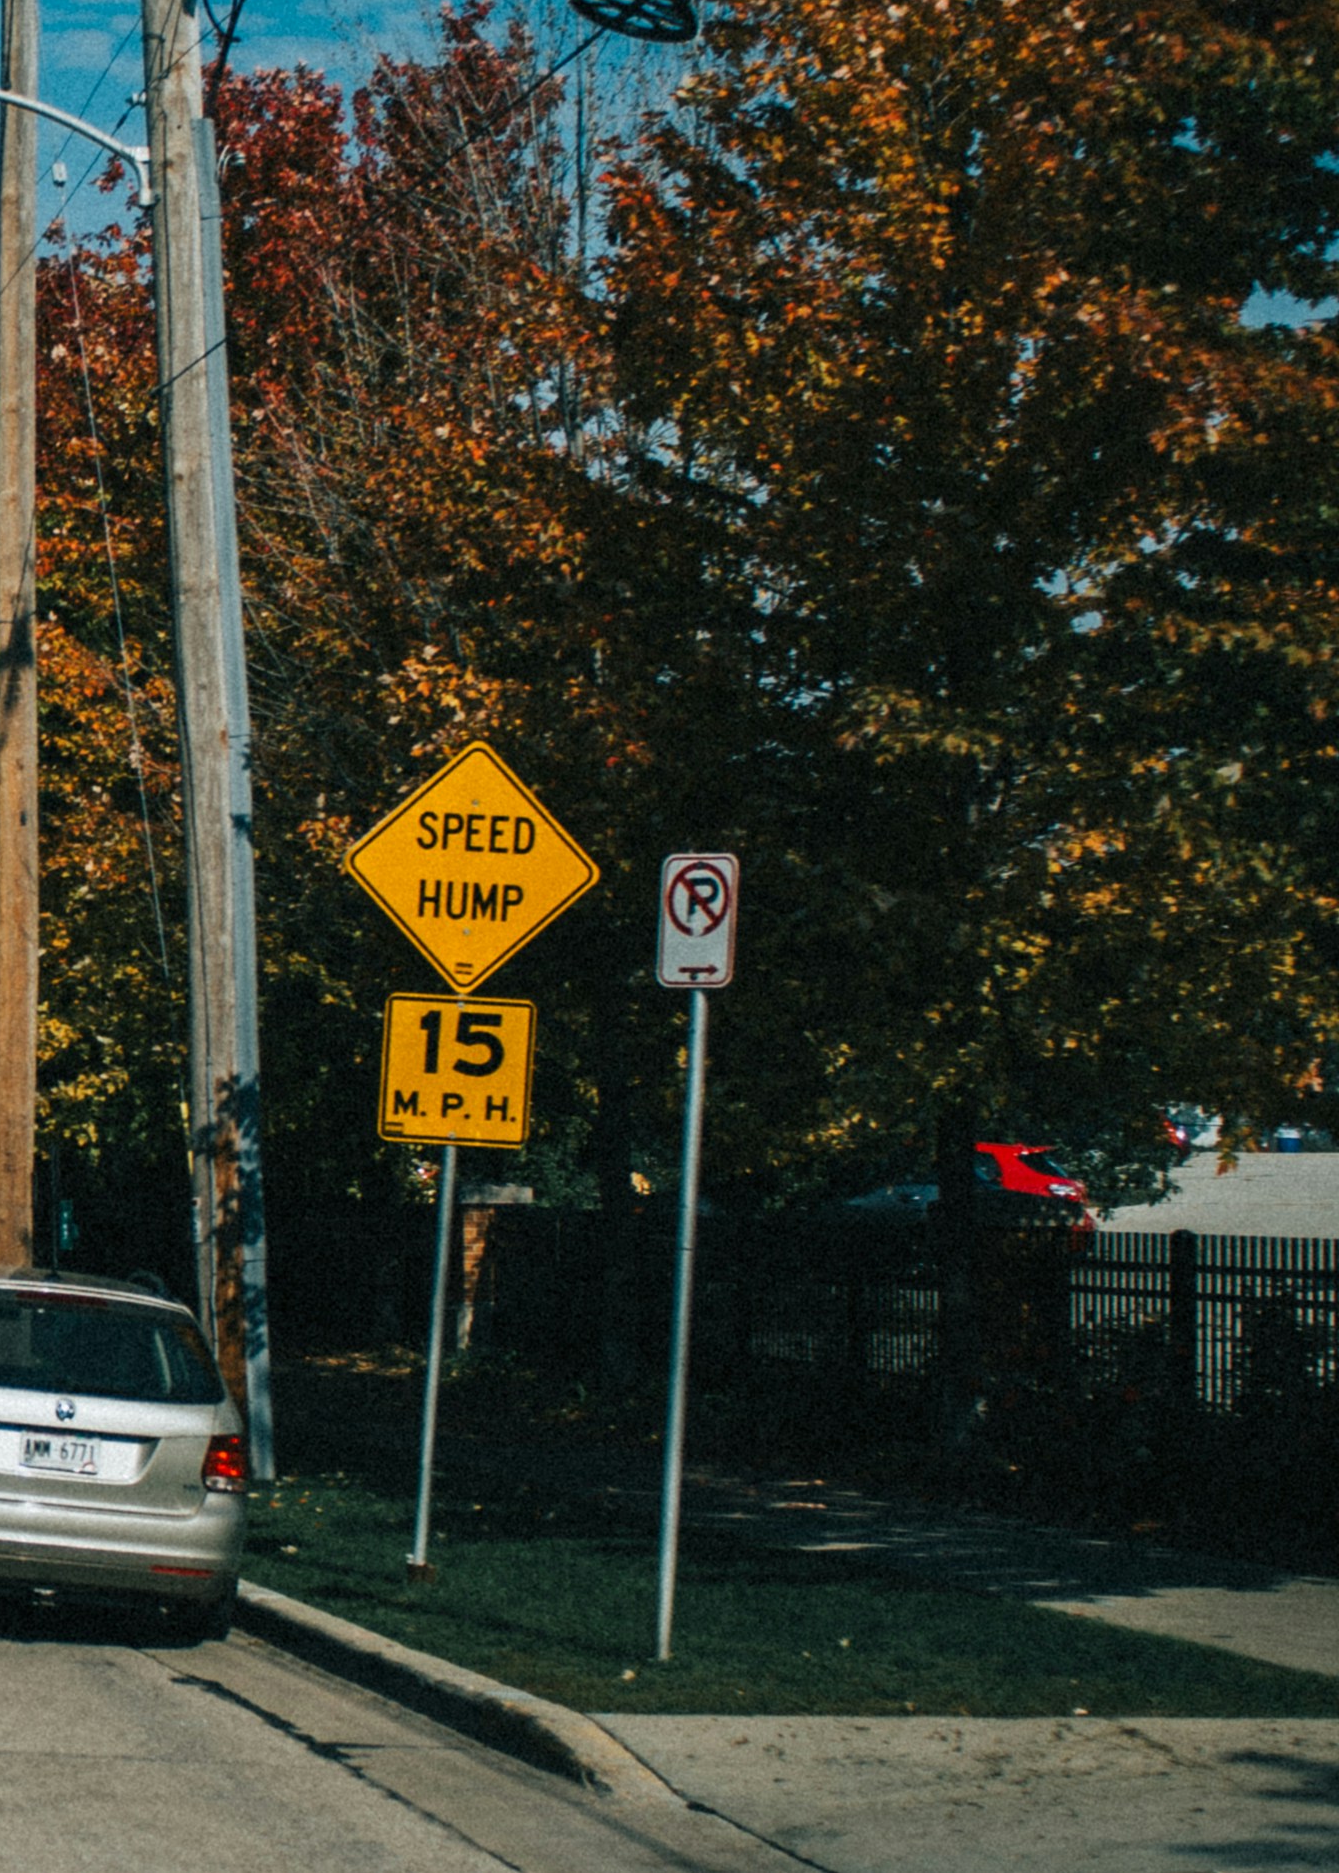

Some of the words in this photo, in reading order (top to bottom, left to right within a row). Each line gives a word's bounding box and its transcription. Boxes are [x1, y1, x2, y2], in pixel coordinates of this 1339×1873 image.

[416, 811, 536, 855] SPEED
[418, 879, 524, 922] HUMP
[420, 1010, 505, 1078] 15
